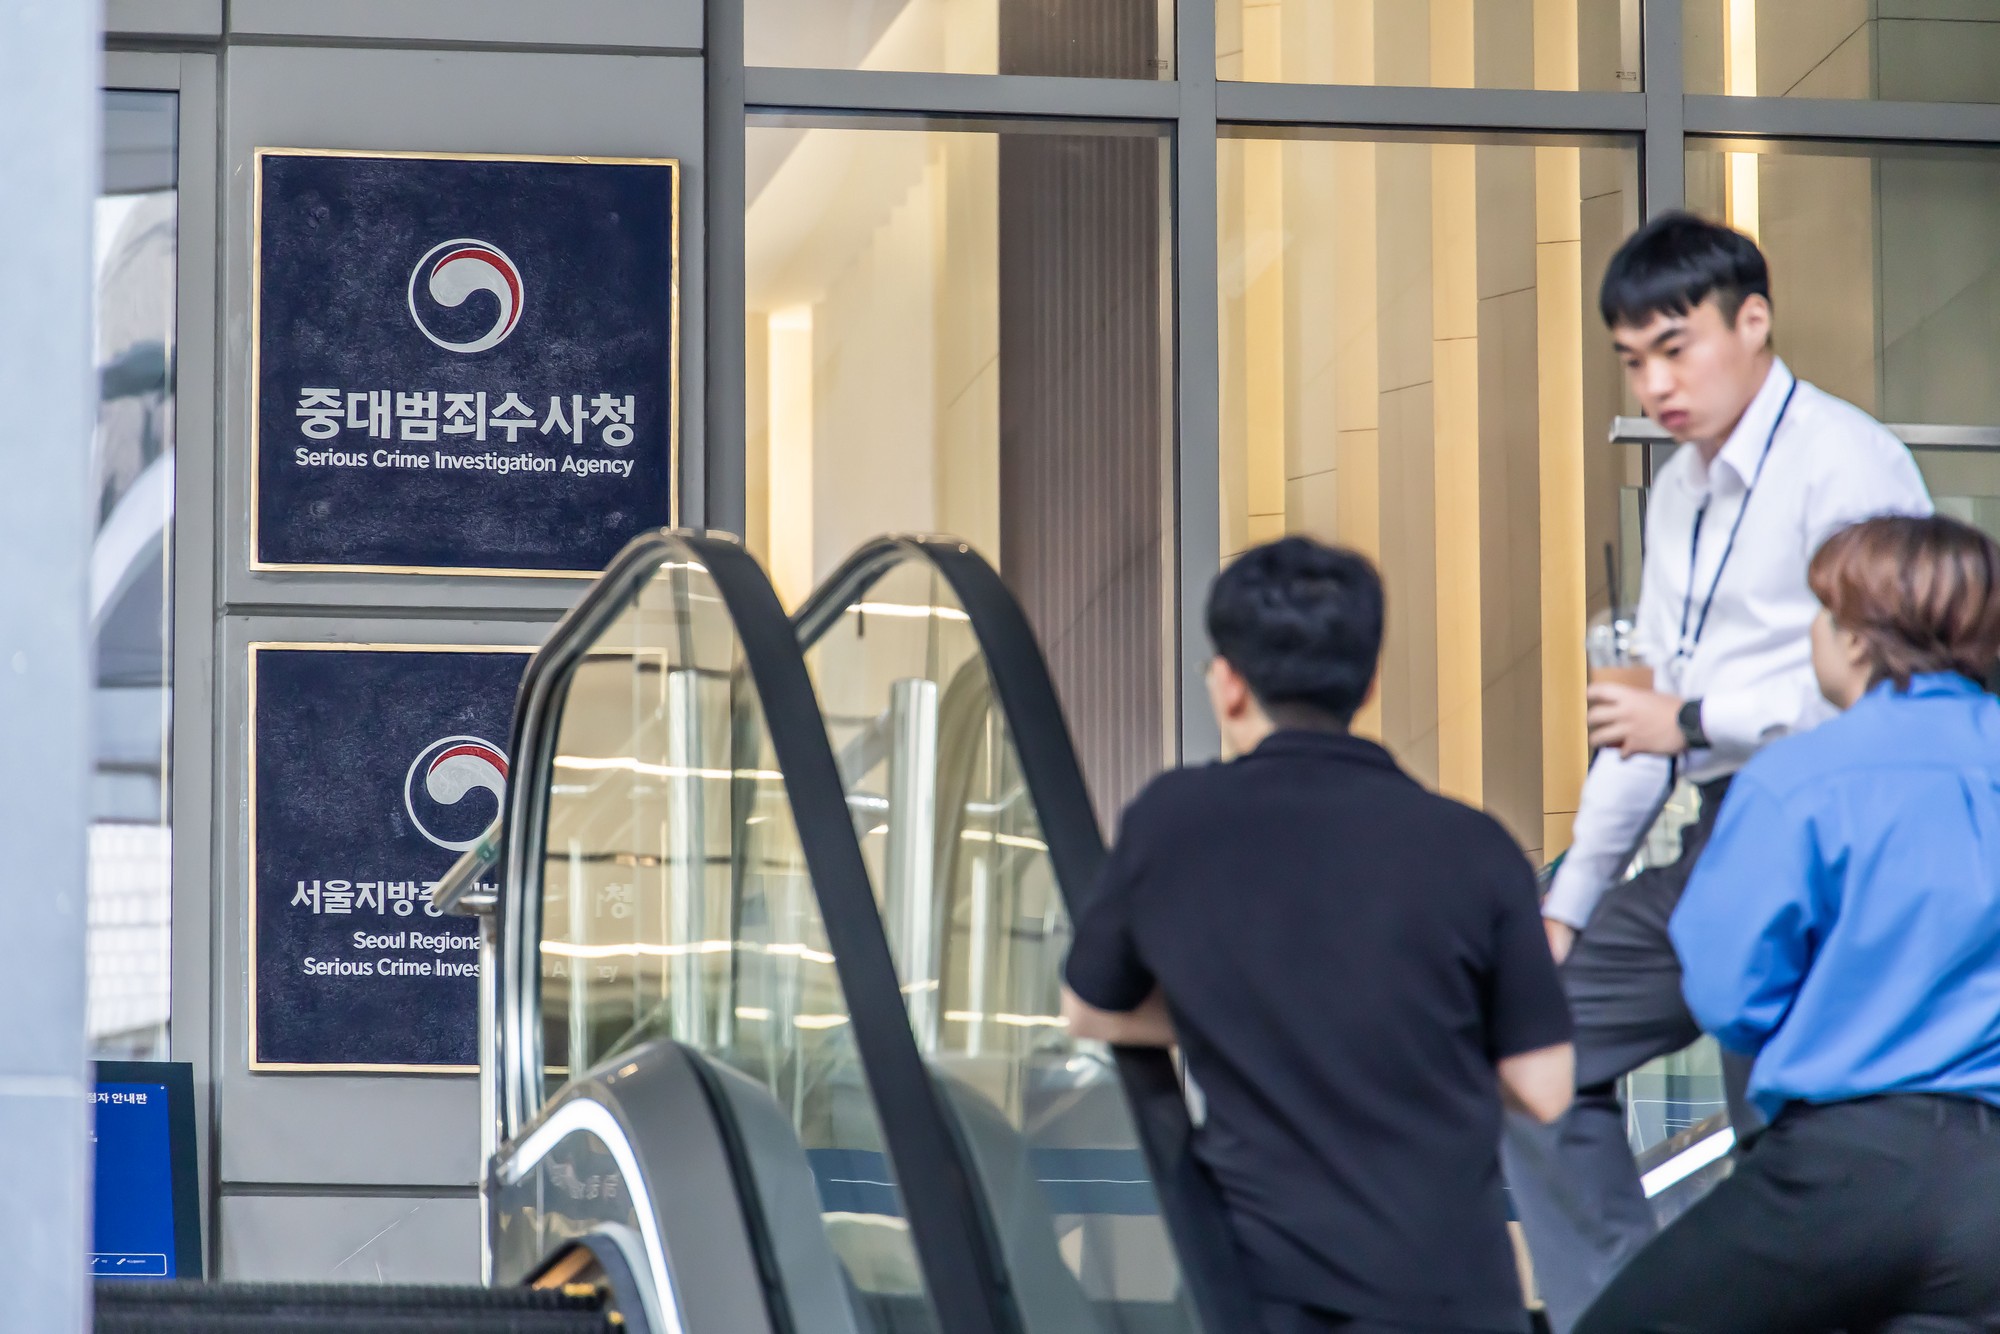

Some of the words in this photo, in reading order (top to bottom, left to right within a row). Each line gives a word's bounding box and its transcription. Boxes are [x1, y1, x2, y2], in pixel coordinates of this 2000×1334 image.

[296, 387, 636, 447] 중대범죄수사청
[295, 447, 368, 467] Serious
[372, 450, 430, 469] Crime
[435, 451, 557, 475] Investigation
[561, 455, 635, 478] Agency
[353, 931, 405, 949] Seoul
[410, 931, 481, 954] Regiona
[303, 957, 374, 976] Serious
[377, 957, 431, 976] Crime
[111, 1092, 148, 1105] 안내판
